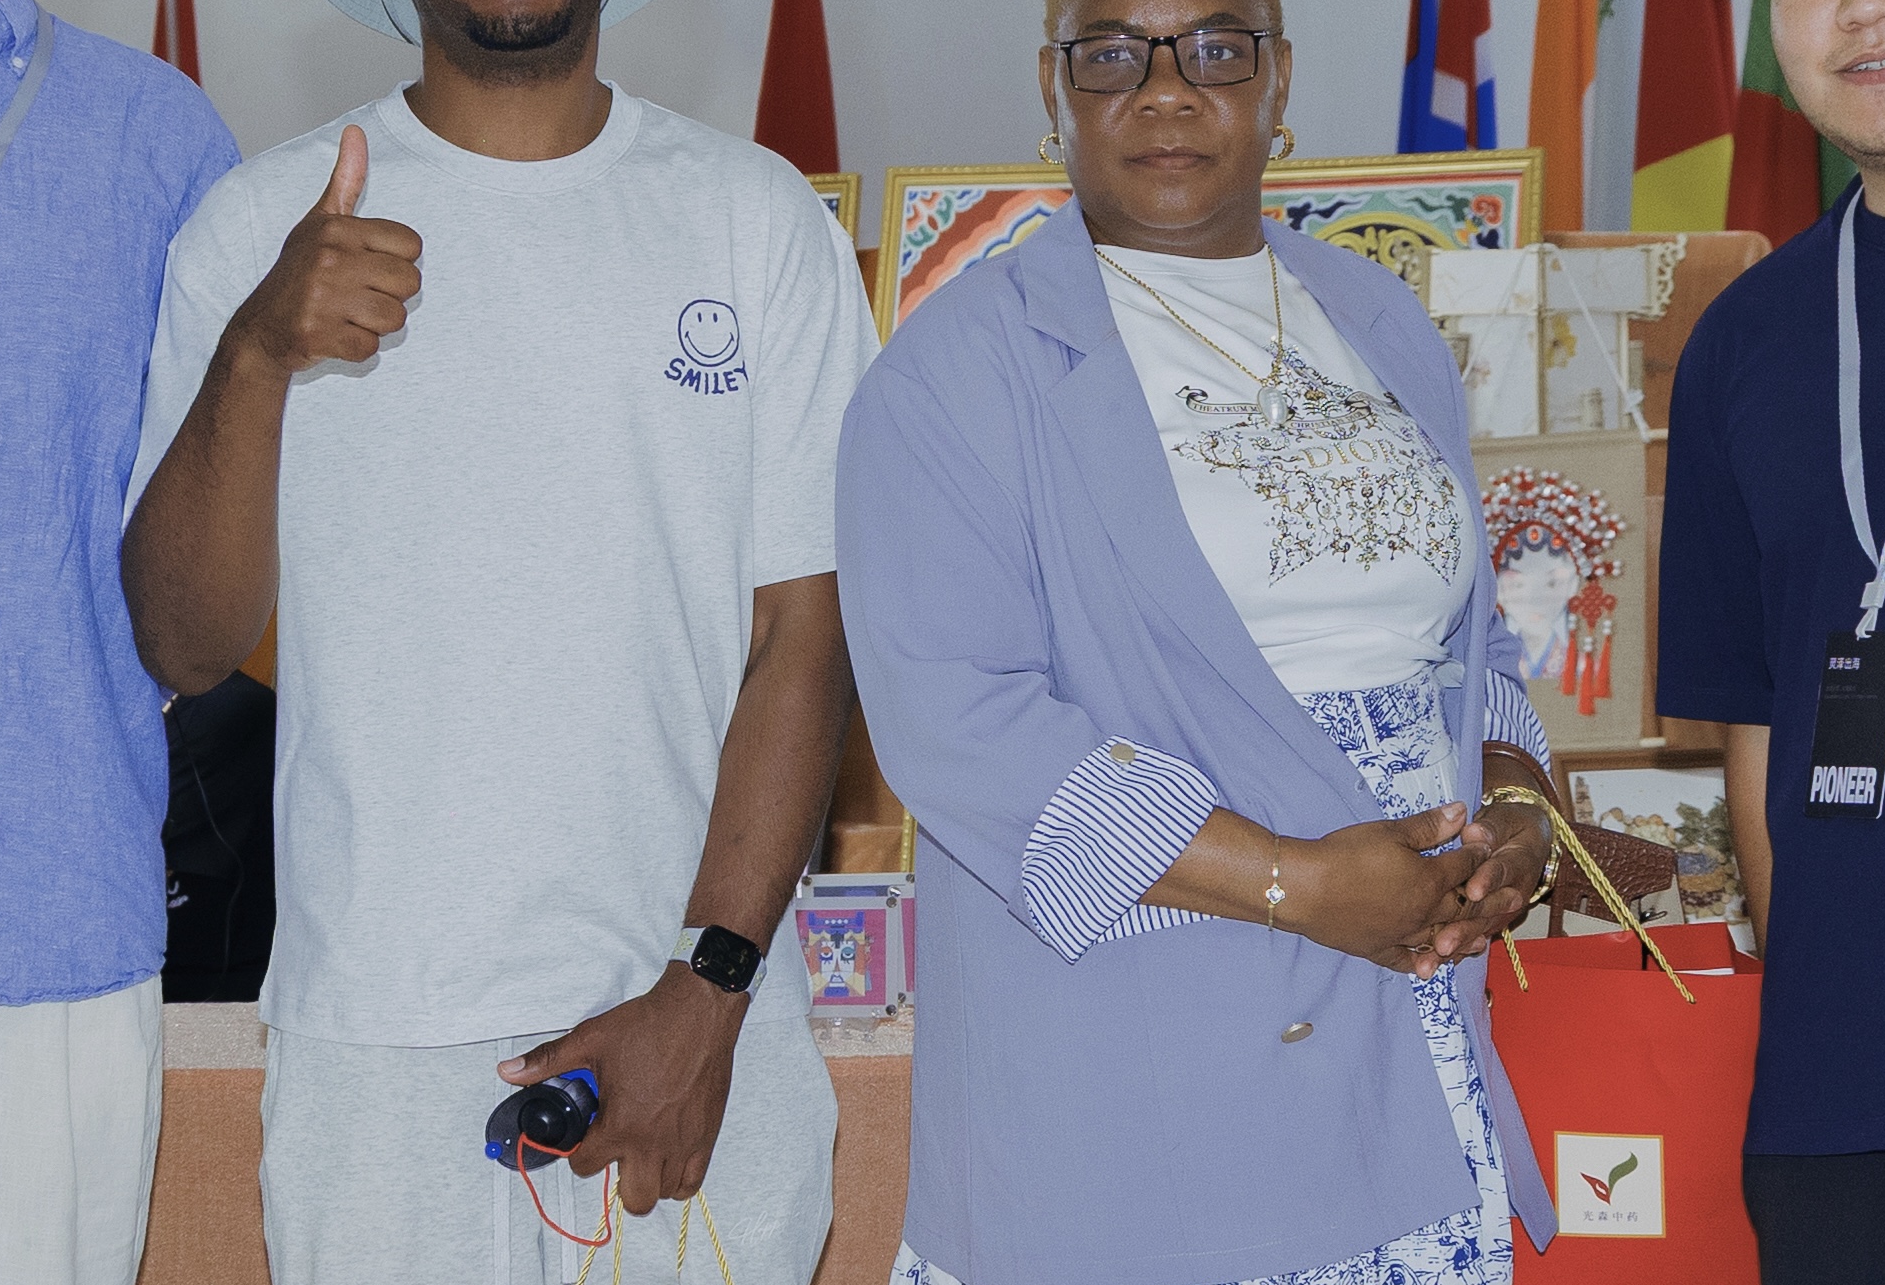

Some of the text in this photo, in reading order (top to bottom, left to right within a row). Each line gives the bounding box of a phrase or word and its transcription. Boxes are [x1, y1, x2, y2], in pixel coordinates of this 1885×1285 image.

[664, 357, 749, 395] SMILEY
[1299, 437, 1405, 469] DIOR
[1810, 765, 1878, 805] PIONEER
